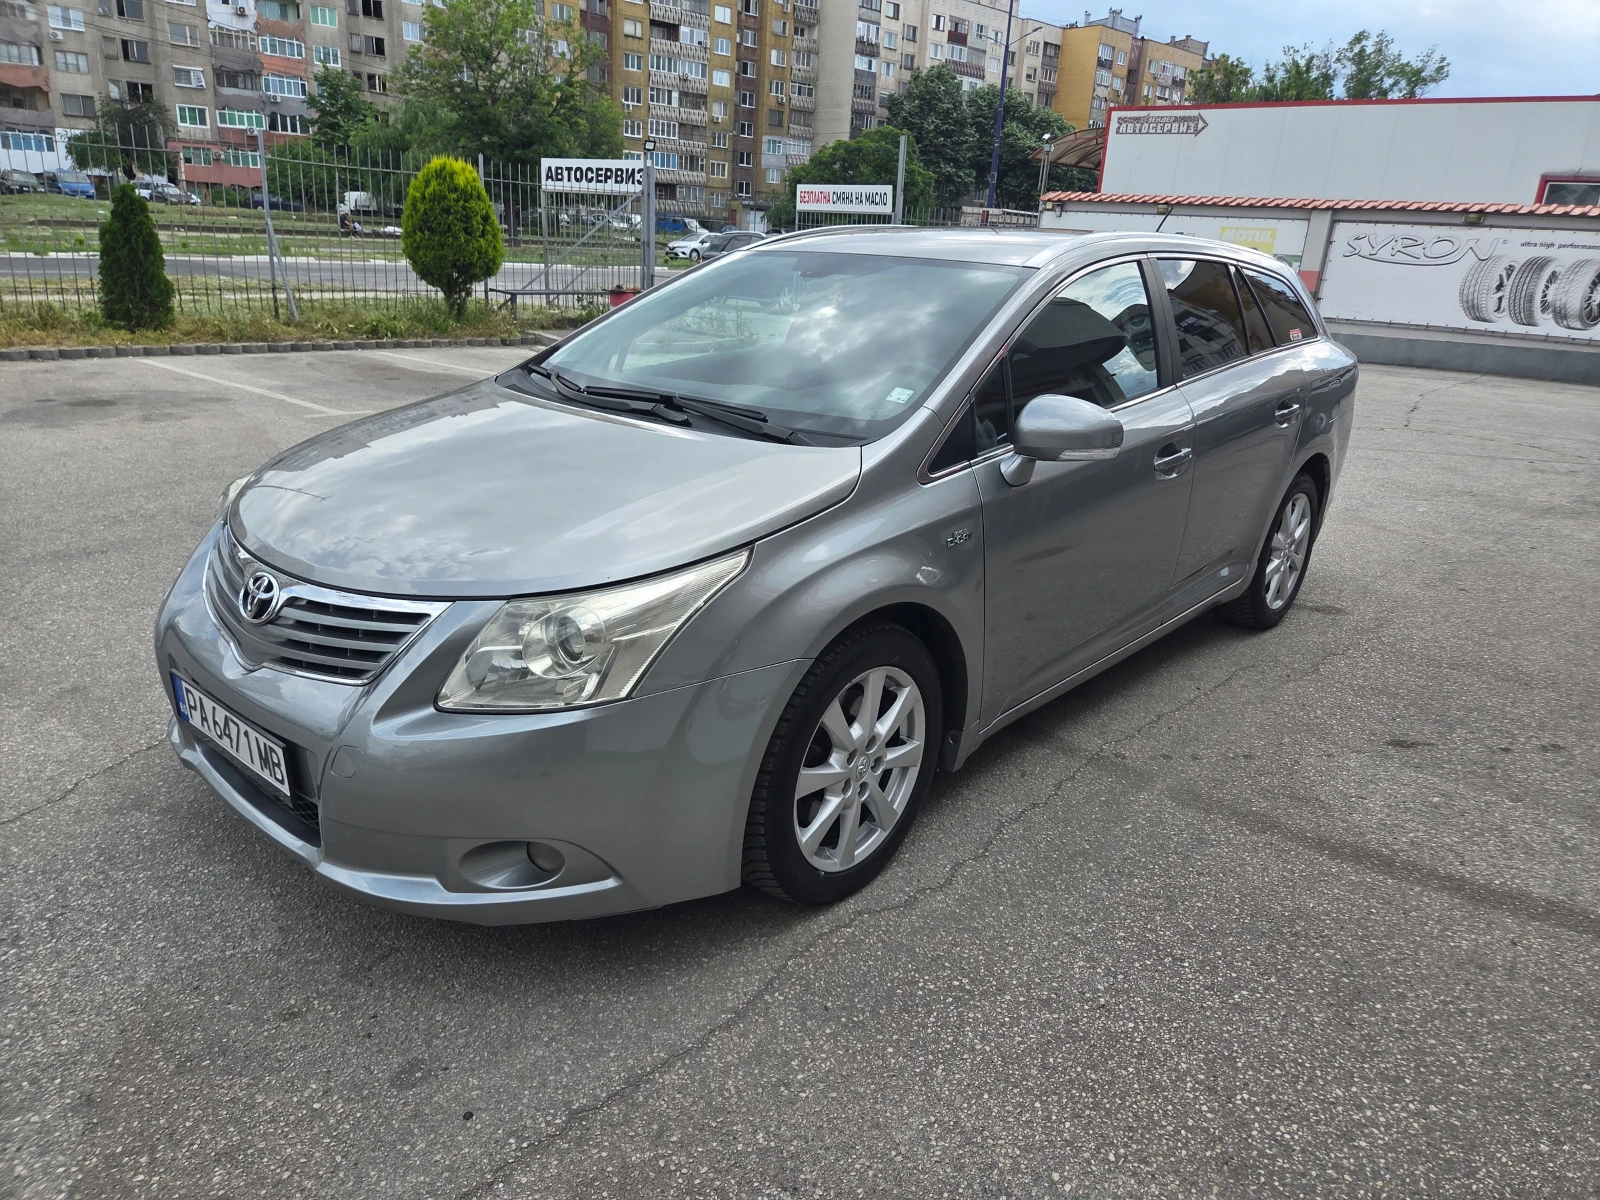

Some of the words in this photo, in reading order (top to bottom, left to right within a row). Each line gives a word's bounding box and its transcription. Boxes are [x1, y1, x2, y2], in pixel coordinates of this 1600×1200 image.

[1119, 122, 1195, 134] АВТОСЕРВИЗ
[545, 166, 644, 185] АВТОСЕРВИЗ
[800, 190, 831, 205] БЕЗПЛАТНА
[832, 191, 853, 206] СМЯНА
[855, 192, 863, 206] НА
[865, 192, 888, 206] МАСЛО
[1221, 228, 1273, 243] MOTUL
[1343, 233, 1500, 266] SYRON
[1539, 241, 1555, 250] high
